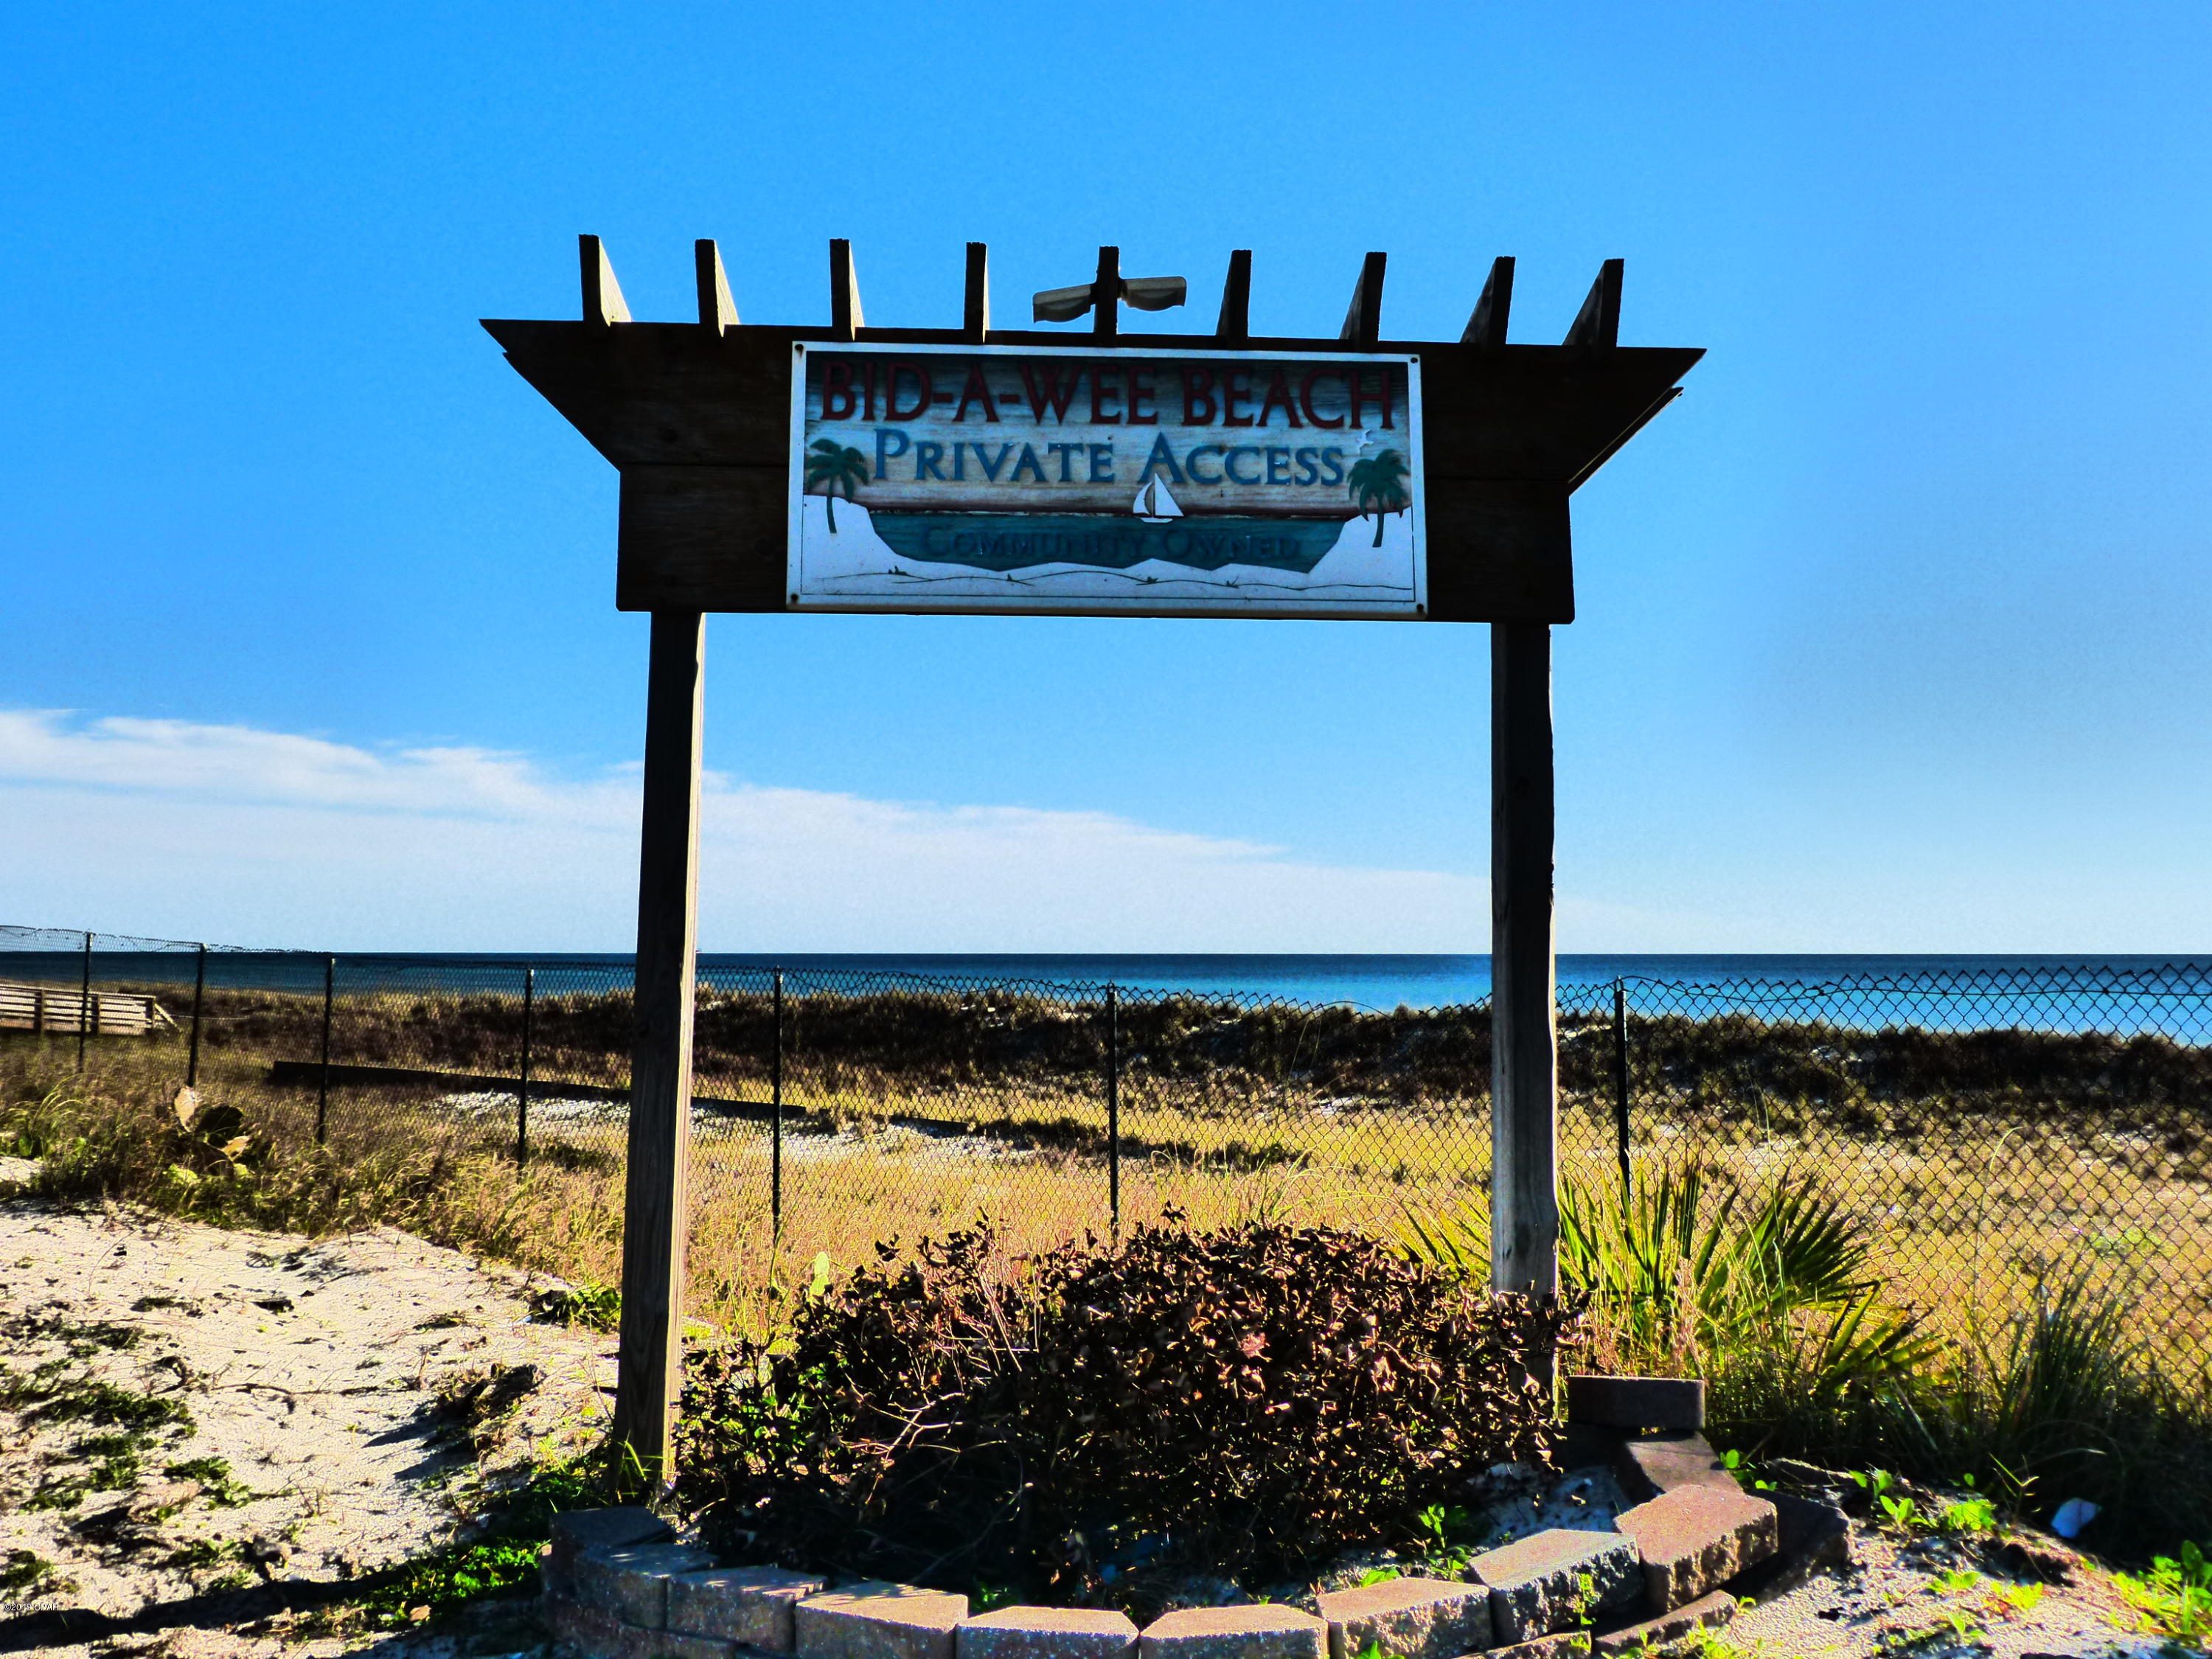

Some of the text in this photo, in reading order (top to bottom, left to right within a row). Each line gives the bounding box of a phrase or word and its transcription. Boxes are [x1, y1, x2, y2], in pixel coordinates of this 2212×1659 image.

[821, 361, 1394, 430] BID-A-WEE BEACH
[873, 429, 1343, 487] PRIVATE ACCESS
[923, 524, 1302, 559] COMMUNITY OWNED
